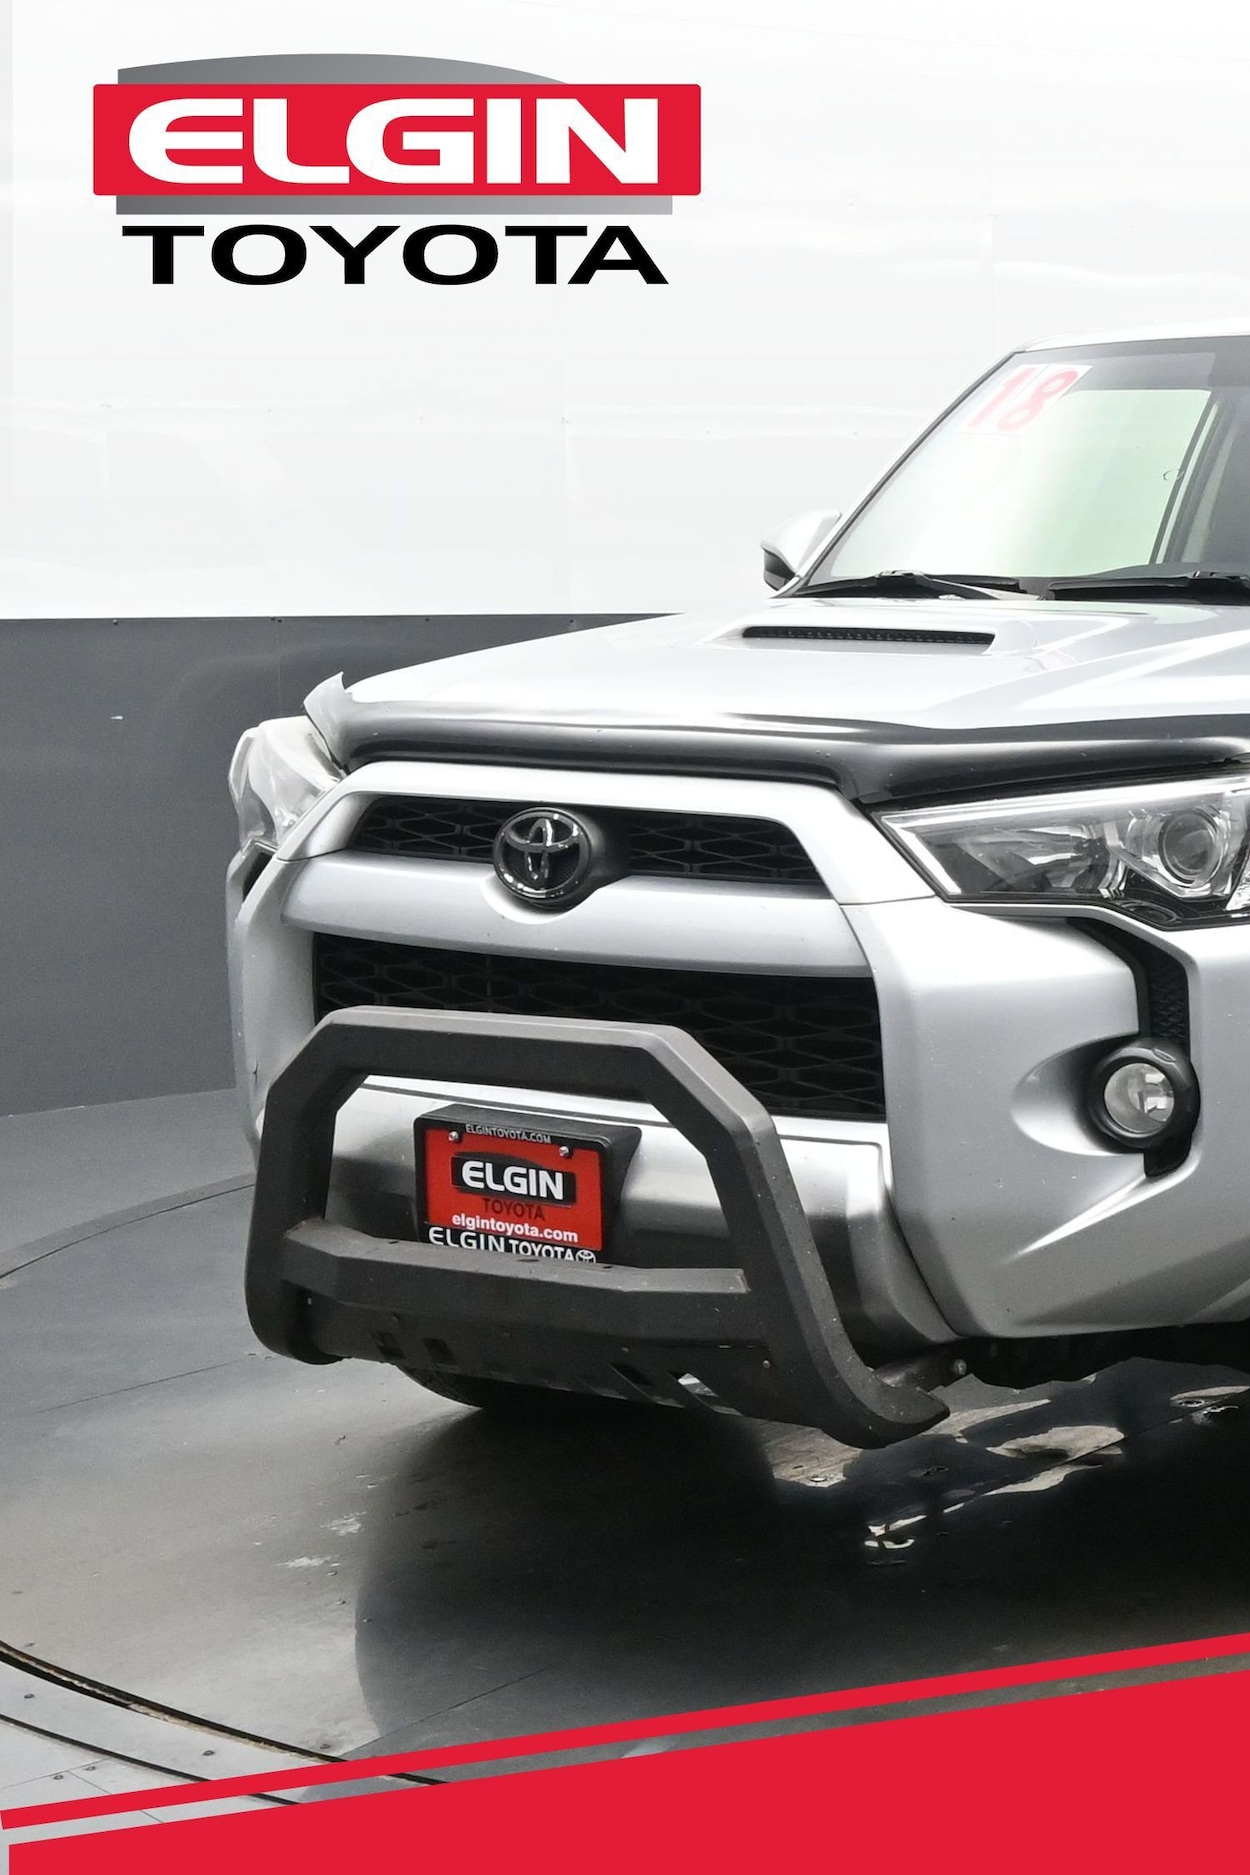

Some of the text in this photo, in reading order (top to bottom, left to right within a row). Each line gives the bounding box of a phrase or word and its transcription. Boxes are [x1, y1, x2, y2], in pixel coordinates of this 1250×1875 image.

[967, 367, 1079, 432] 18
[465, 1124, 552, 1144] ELGINTOYOTA.COM
[462, 1160, 564, 1200] ELGIN
[484, 1199, 544, 1220] TOYOTA
[429, 1226, 574, 1262] ELGIN TOYOTA
[452, 1213, 579, 1243] elgintoyota.com
